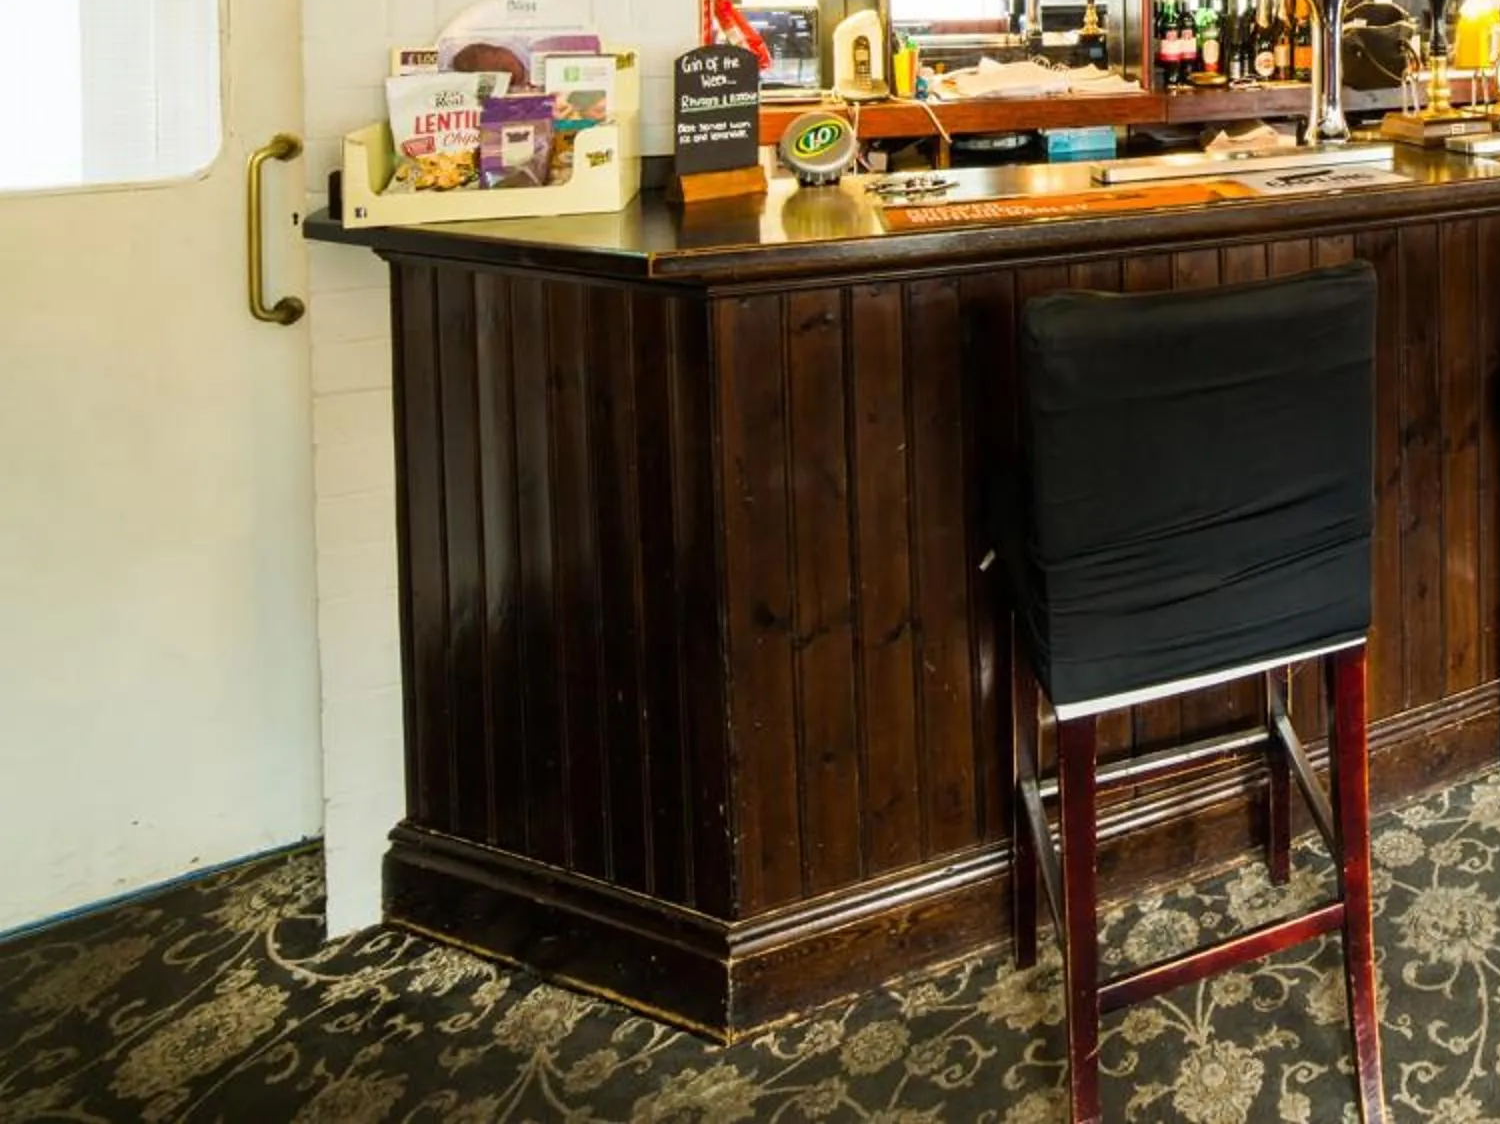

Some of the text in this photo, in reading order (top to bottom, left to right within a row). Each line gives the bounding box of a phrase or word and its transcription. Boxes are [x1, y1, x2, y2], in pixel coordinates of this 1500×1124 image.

[681, 56, 740, 73] Gin of the
